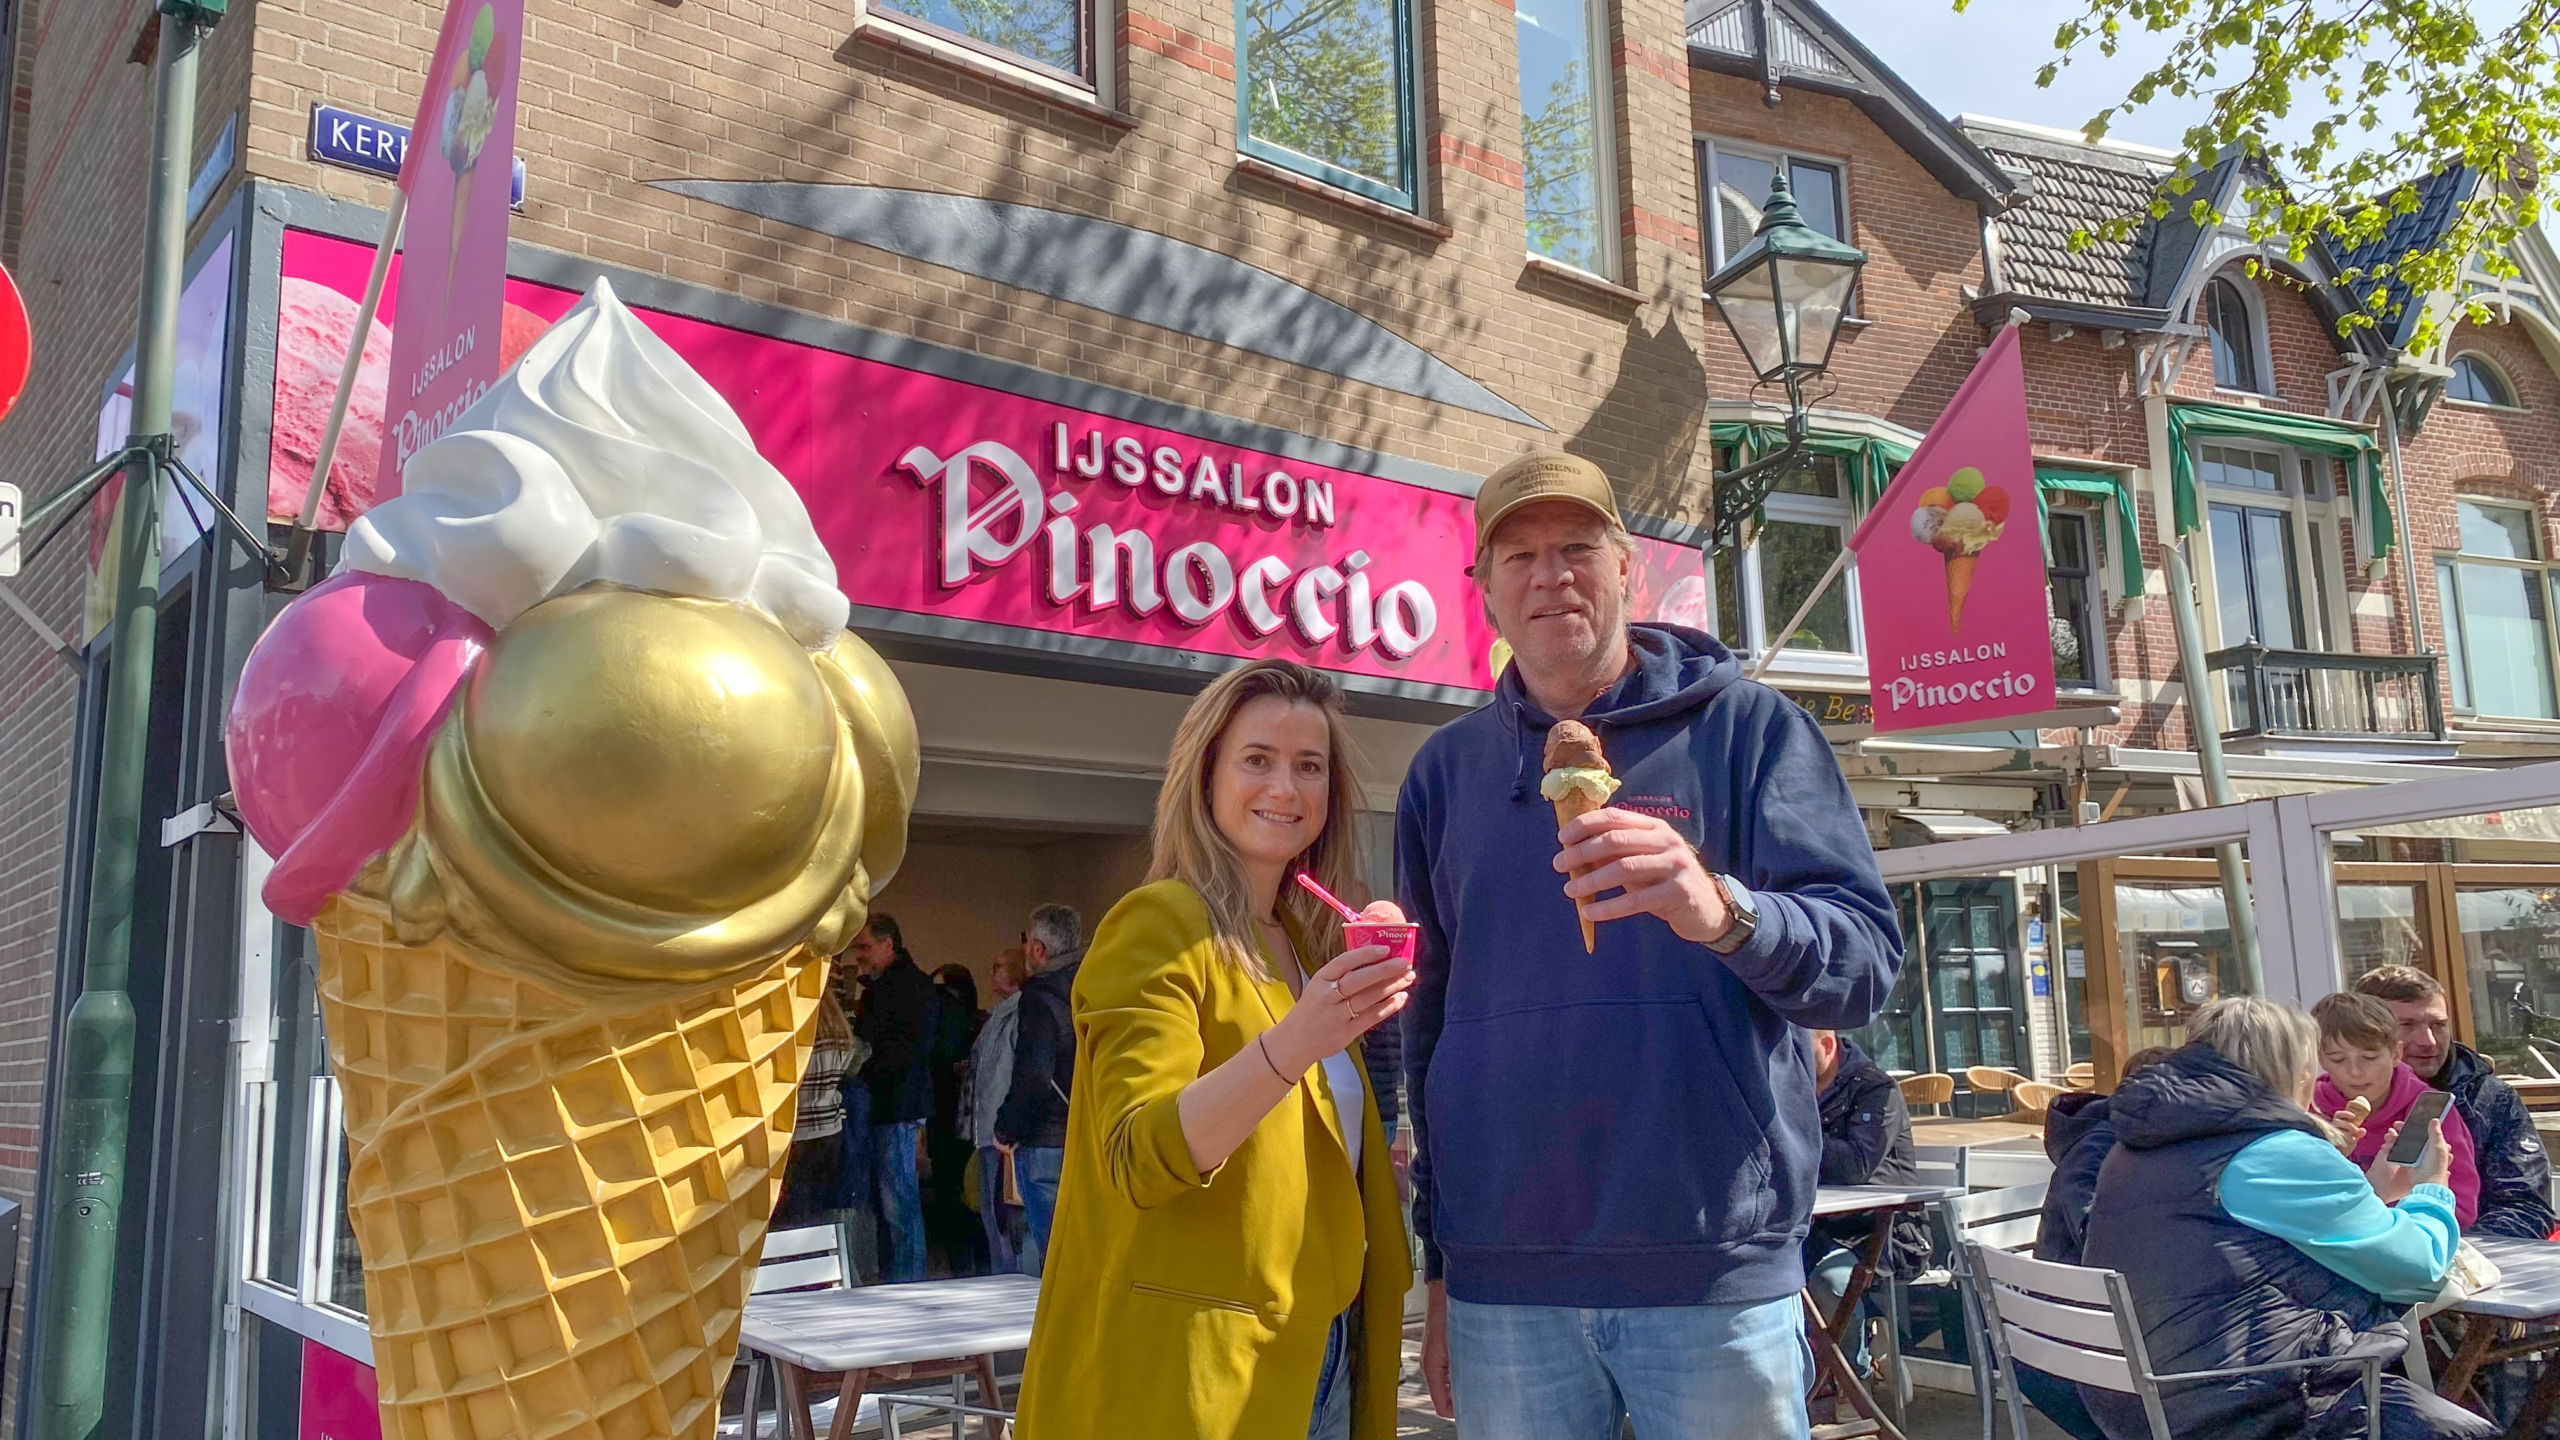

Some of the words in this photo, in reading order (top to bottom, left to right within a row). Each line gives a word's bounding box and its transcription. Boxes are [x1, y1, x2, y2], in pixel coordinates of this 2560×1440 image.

[411, 324, 476, 398] IJSSALON
[1054, 421, 1335, 527] IJSSALON
[1527, 463, 1582, 476] LEGEND
[897, 439, 1438, 658] Pinoccio
[1900, 642, 2007, 672] IJSSALON
[1880, 669, 2037, 713] Pinoccio
